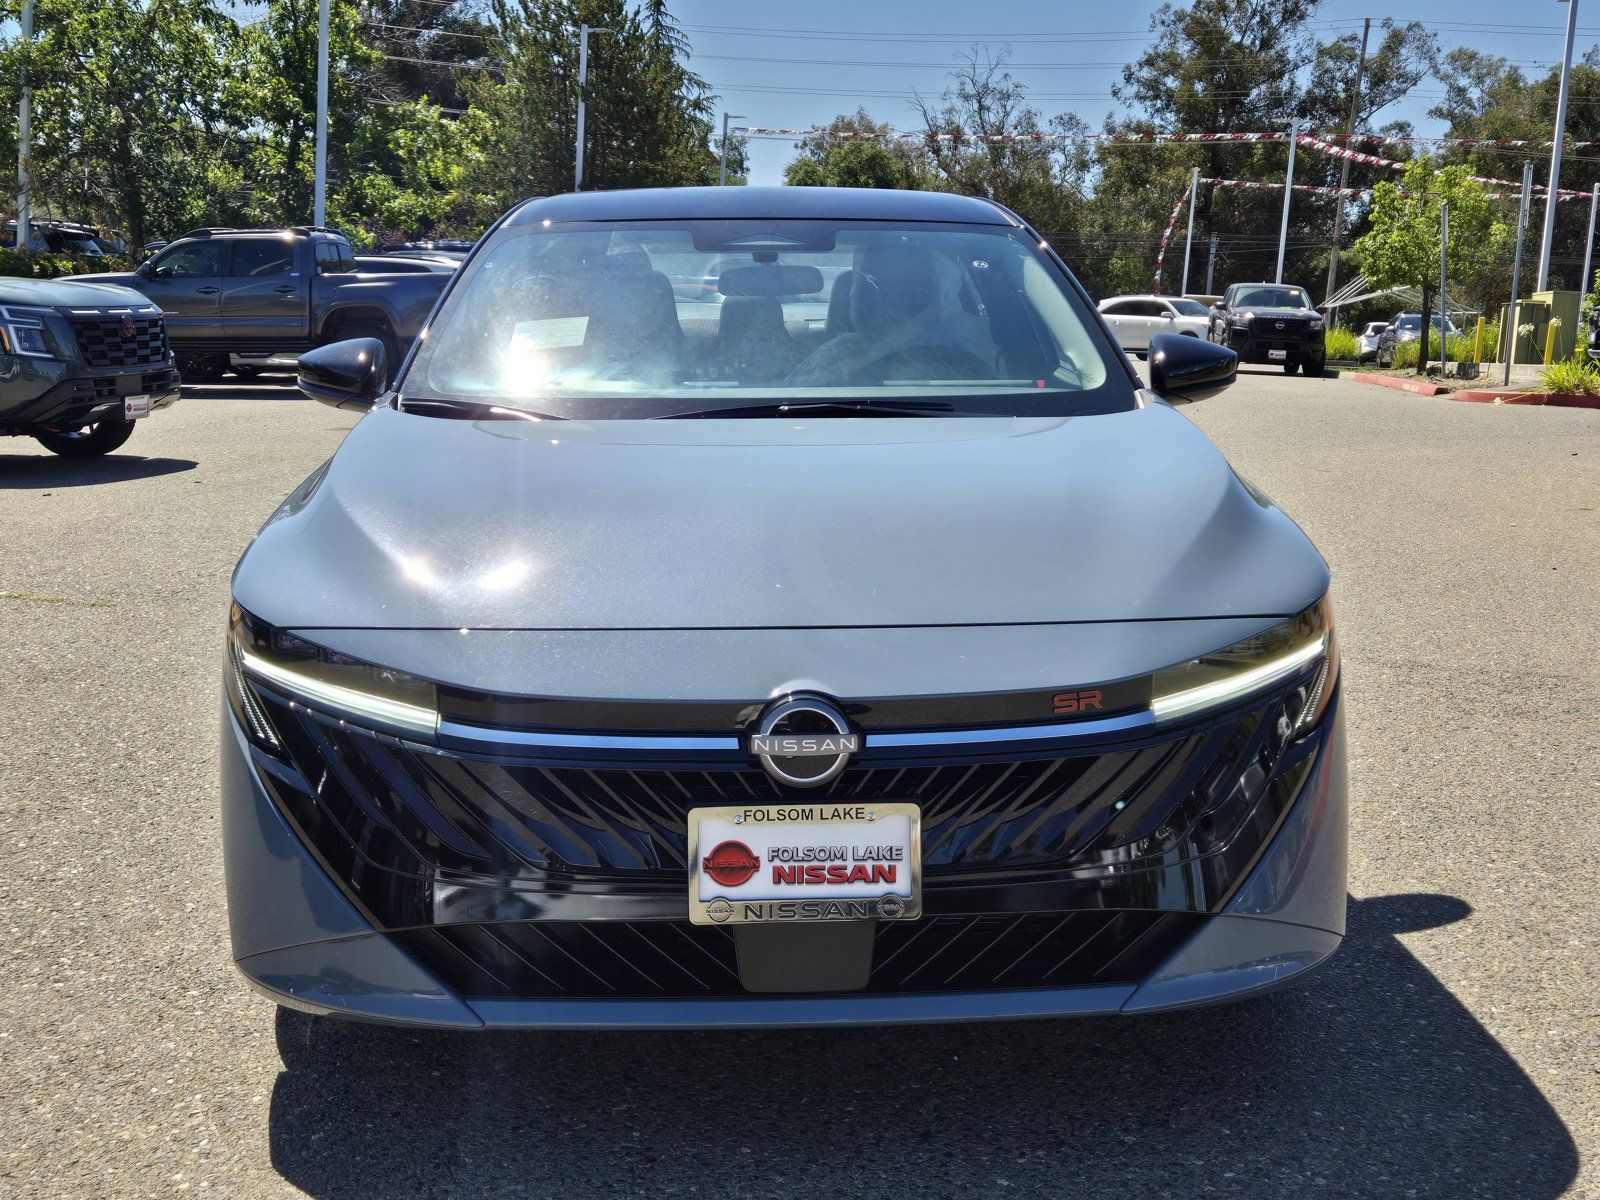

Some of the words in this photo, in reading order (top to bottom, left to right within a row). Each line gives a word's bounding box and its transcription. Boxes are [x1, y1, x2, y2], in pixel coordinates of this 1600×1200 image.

[1053, 690, 1103, 714] SR
[754, 738, 855, 752] NISSAN
[743, 808, 814, 822] FOLSOM
[820, 807, 865, 820] LAKE
[767, 846, 848, 862] FOLSOM
[852, 846, 904, 861] LAKE
[702, 856, 761, 869] NISSAN
[772, 864, 897, 885] NISSAN
[743, 901, 869, 920] NISSAN
